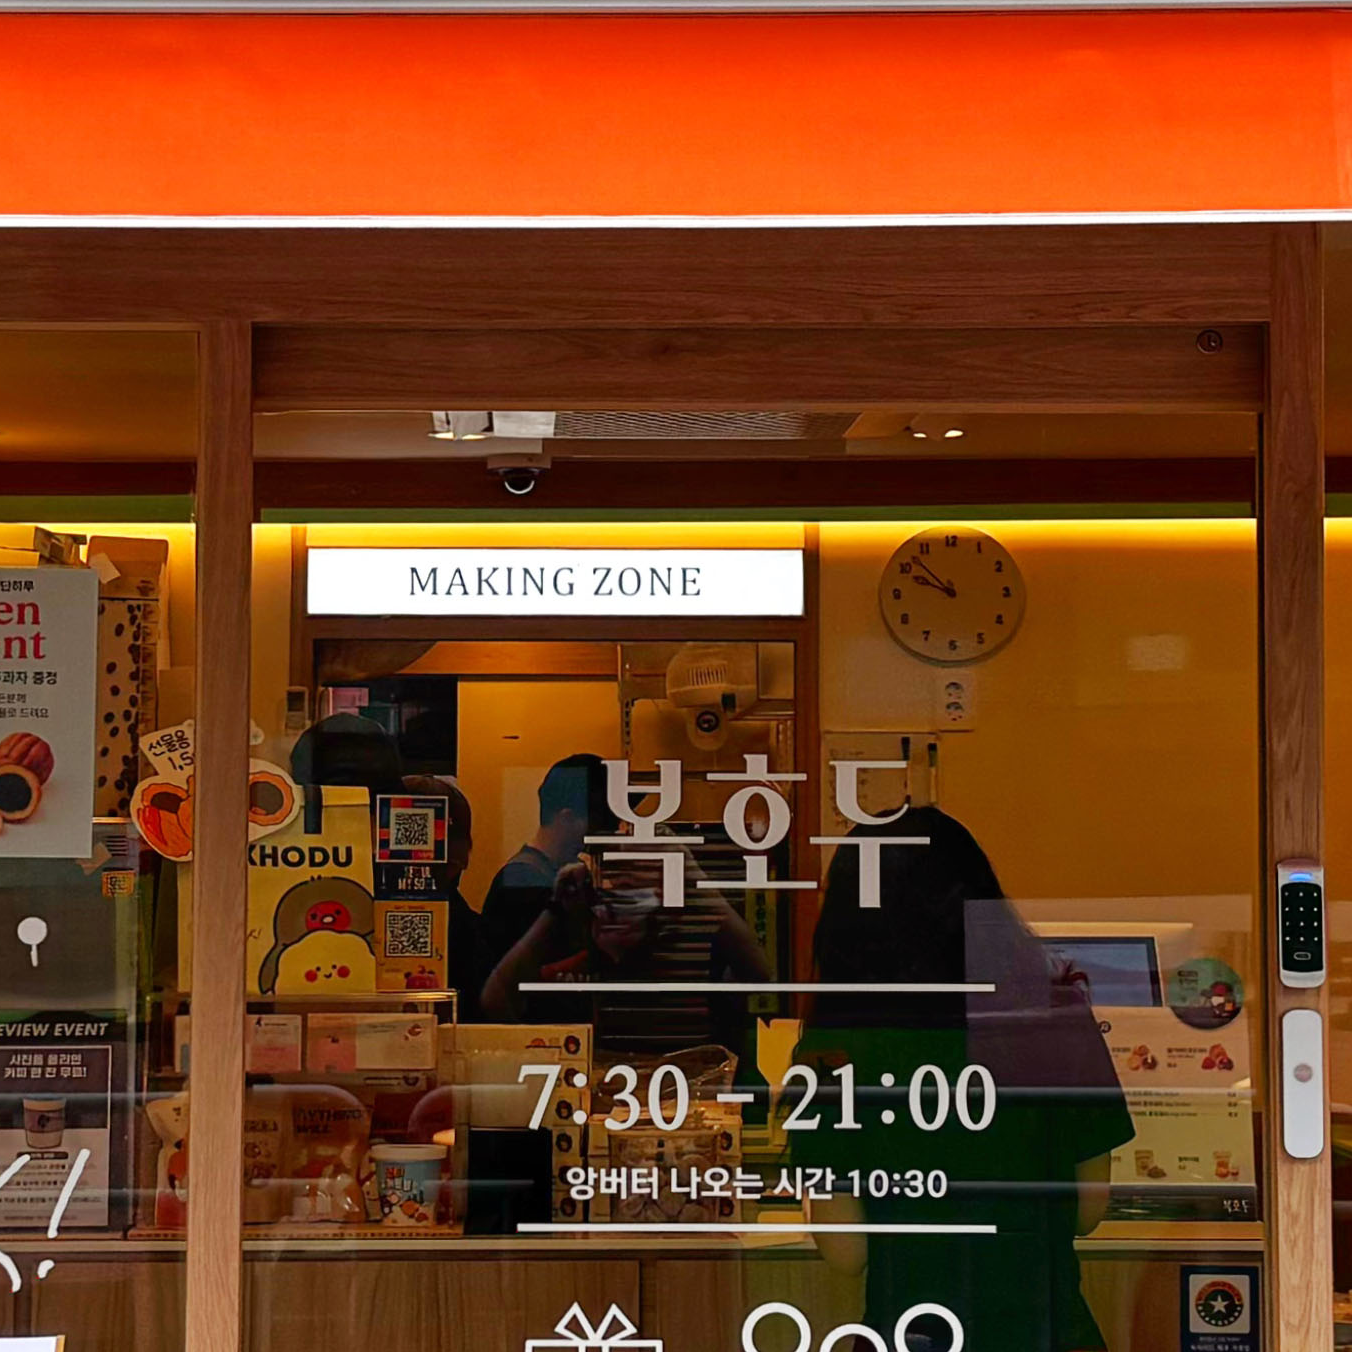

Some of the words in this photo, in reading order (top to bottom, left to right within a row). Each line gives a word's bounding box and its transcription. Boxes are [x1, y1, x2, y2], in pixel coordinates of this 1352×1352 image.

[0, 580, 34, 592] 단하루
[408, 566, 576, 597] MAKING
[592, 566, 703, 597] ZONE
[32, 671, 57, 685] 증정
[168, 752, 194, 772] 1,5
[584, 753, 931, 909] 복호두
[54, 1023, 108, 1037] EVENT
[517, 1064, 690, 1131] 7:30
[781, 1063, 997, 1131] 21:00
[566, 1166, 660, 1200] 앙버터
[669, 1166, 764, 1198] 나오는
[773, 1167, 836, 1200] 시간
[847, 1169, 948, 1199] 10:30
